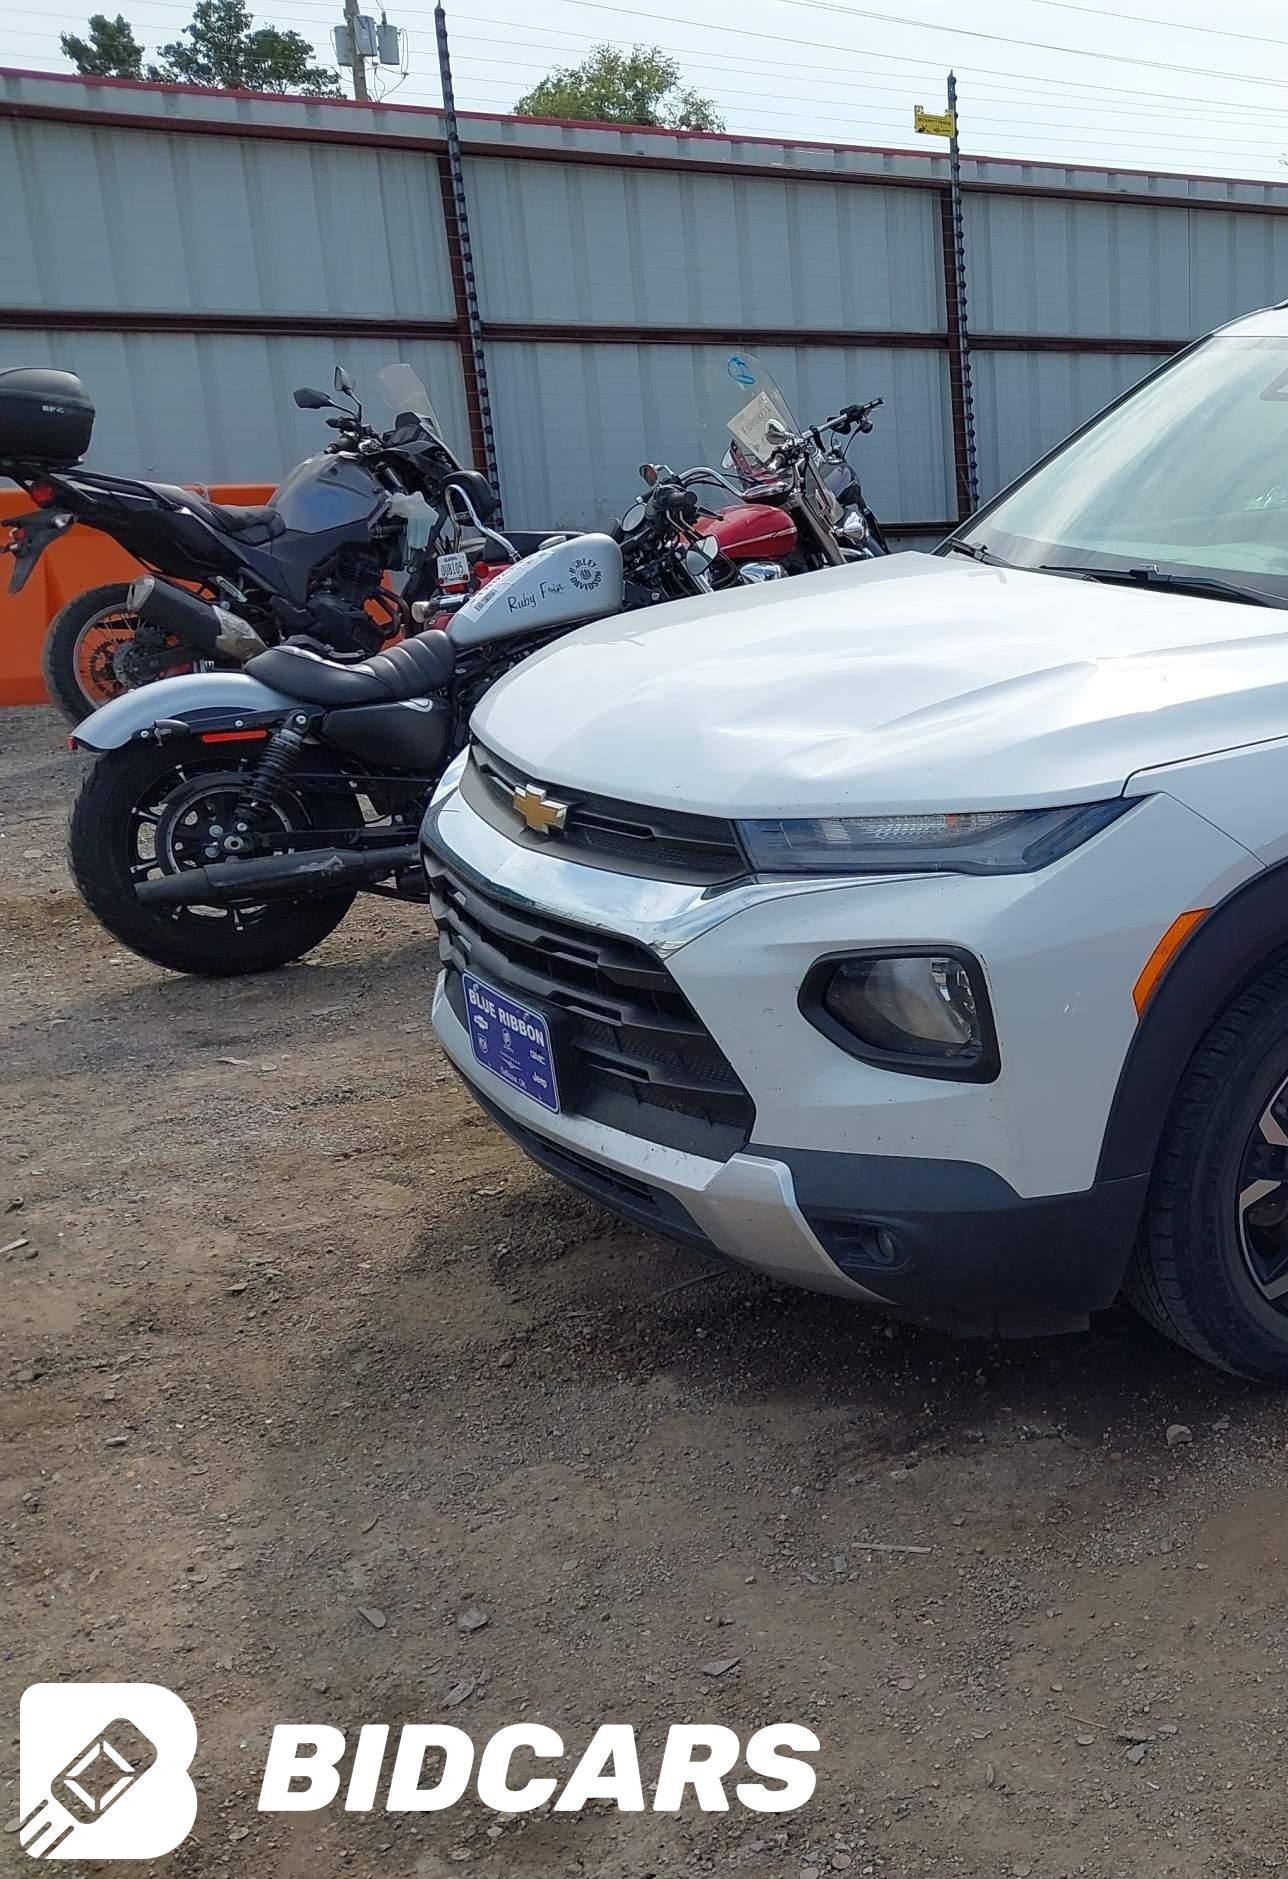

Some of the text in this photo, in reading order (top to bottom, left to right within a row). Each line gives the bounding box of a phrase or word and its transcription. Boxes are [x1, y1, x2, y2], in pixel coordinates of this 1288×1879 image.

[569, 570, 602, 590] DAVIDSON
[508, 593, 537, 613] Ruby
[468, 988, 545, 1048] BLUE RIBBON
